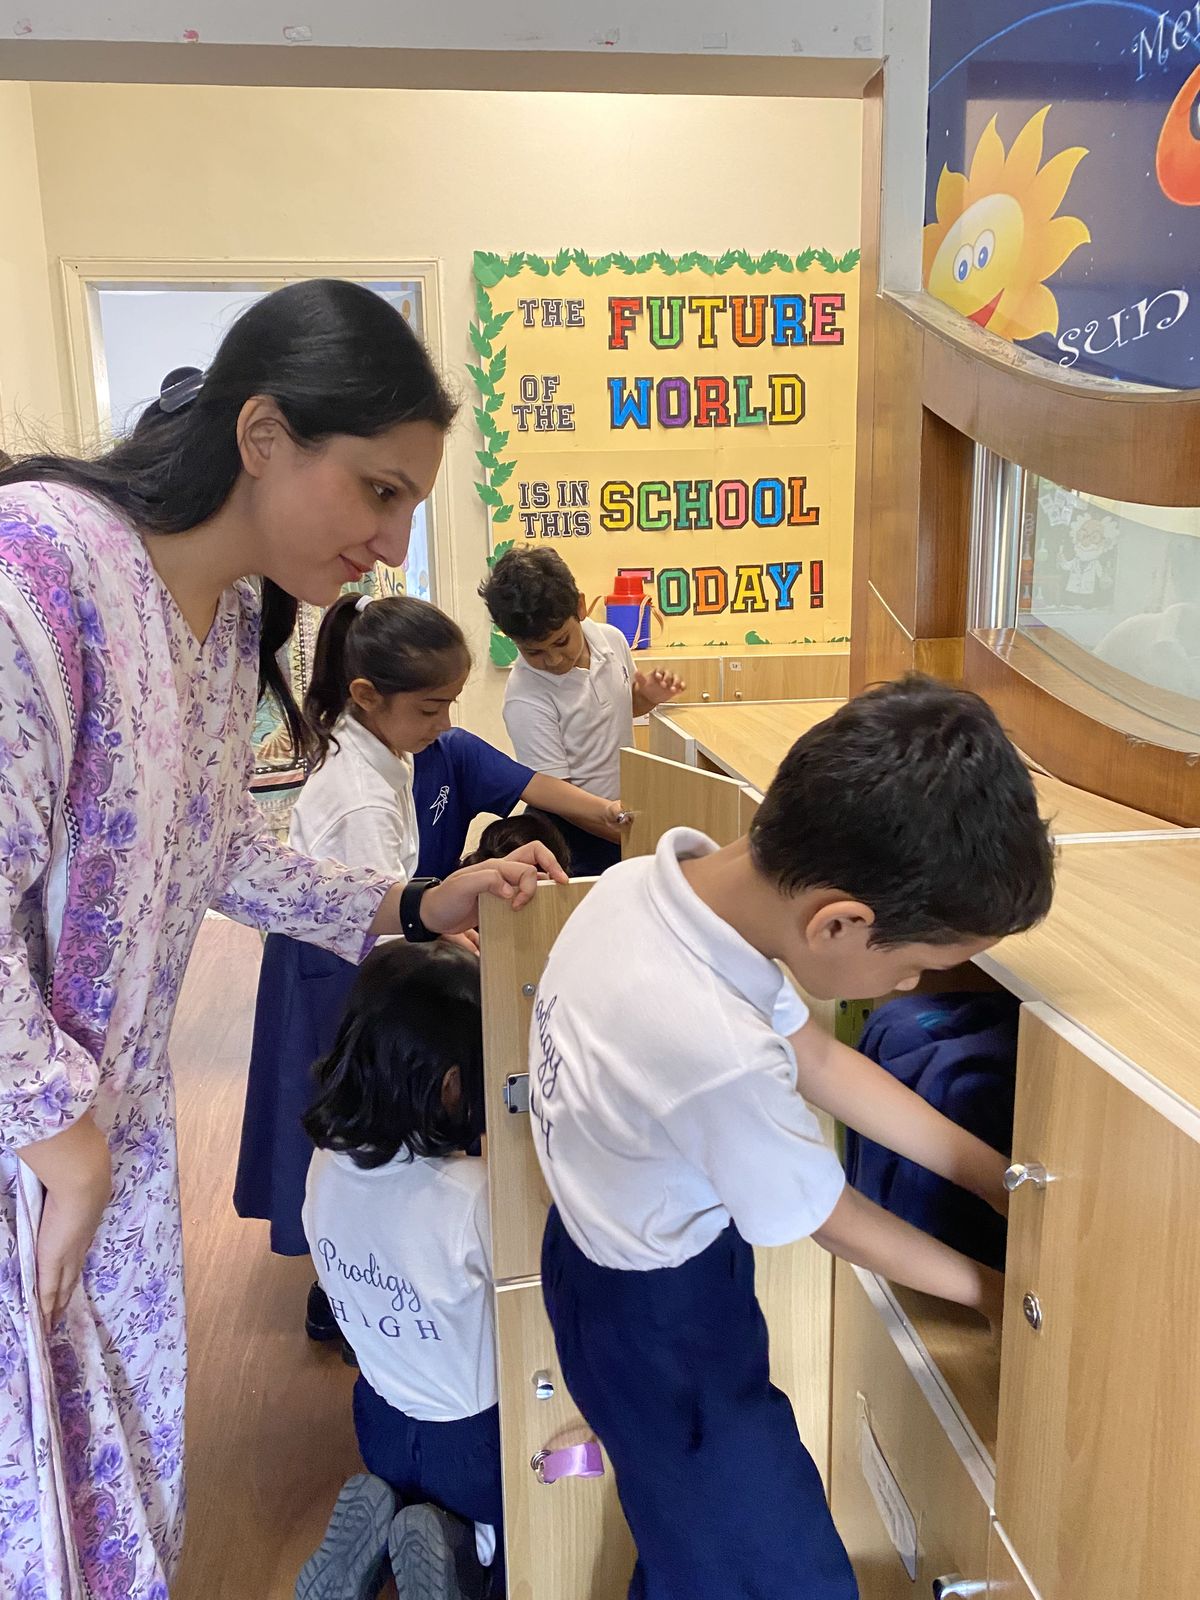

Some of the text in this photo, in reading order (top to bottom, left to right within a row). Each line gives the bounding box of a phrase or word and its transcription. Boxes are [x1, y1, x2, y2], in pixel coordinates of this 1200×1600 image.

[518, 293, 845, 349] THE FUTURE
[1056, 289, 1190, 368] sun
[520, 374, 560, 402] OF
[607, 374, 806, 429] WORLD
[512, 403, 575, 431] THE
[518, 481, 589, 508] IS IN
[600, 476, 820, 531] SCHOOL
[520, 511, 592, 538] THIS
[317, 1238, 422, 1313] Prodigy
[329, 1296, 443, 1341] HIGH
